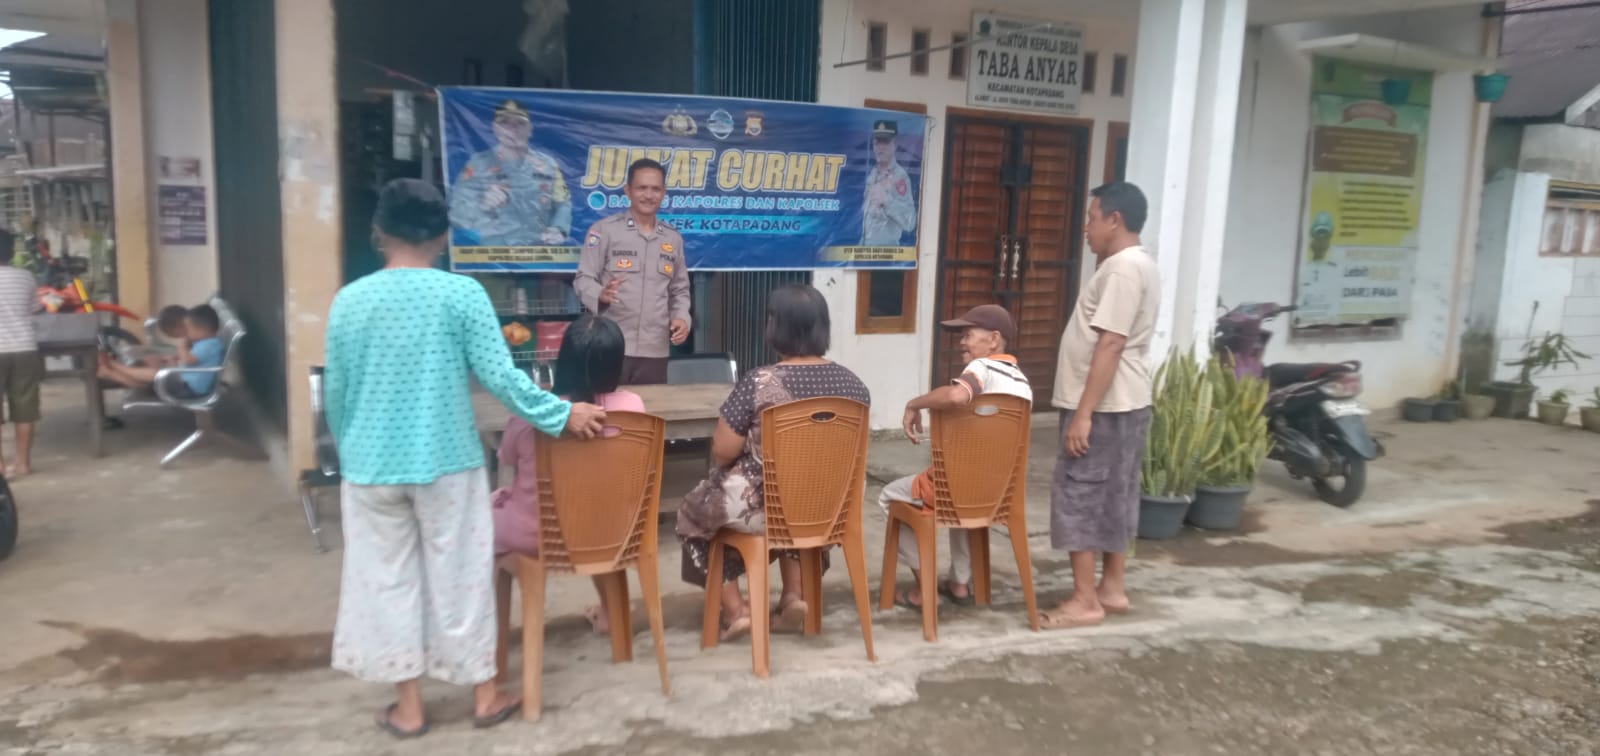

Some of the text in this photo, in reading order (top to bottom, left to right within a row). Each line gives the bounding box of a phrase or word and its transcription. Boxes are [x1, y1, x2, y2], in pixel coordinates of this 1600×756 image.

[1030, 36, 1058, 53] KEPALA
[977, 49, 1078, 86] TABA ANYAR
[580, 144, 847, 193] JU'AT CURHAT
[671, 195, 744, 210] KAPOLRES
[745, 196, 775, 210] DAN
[777, 198, 840, 212] KAPOLSEK
[700, 218, 801, 231] KOTAPADANG
